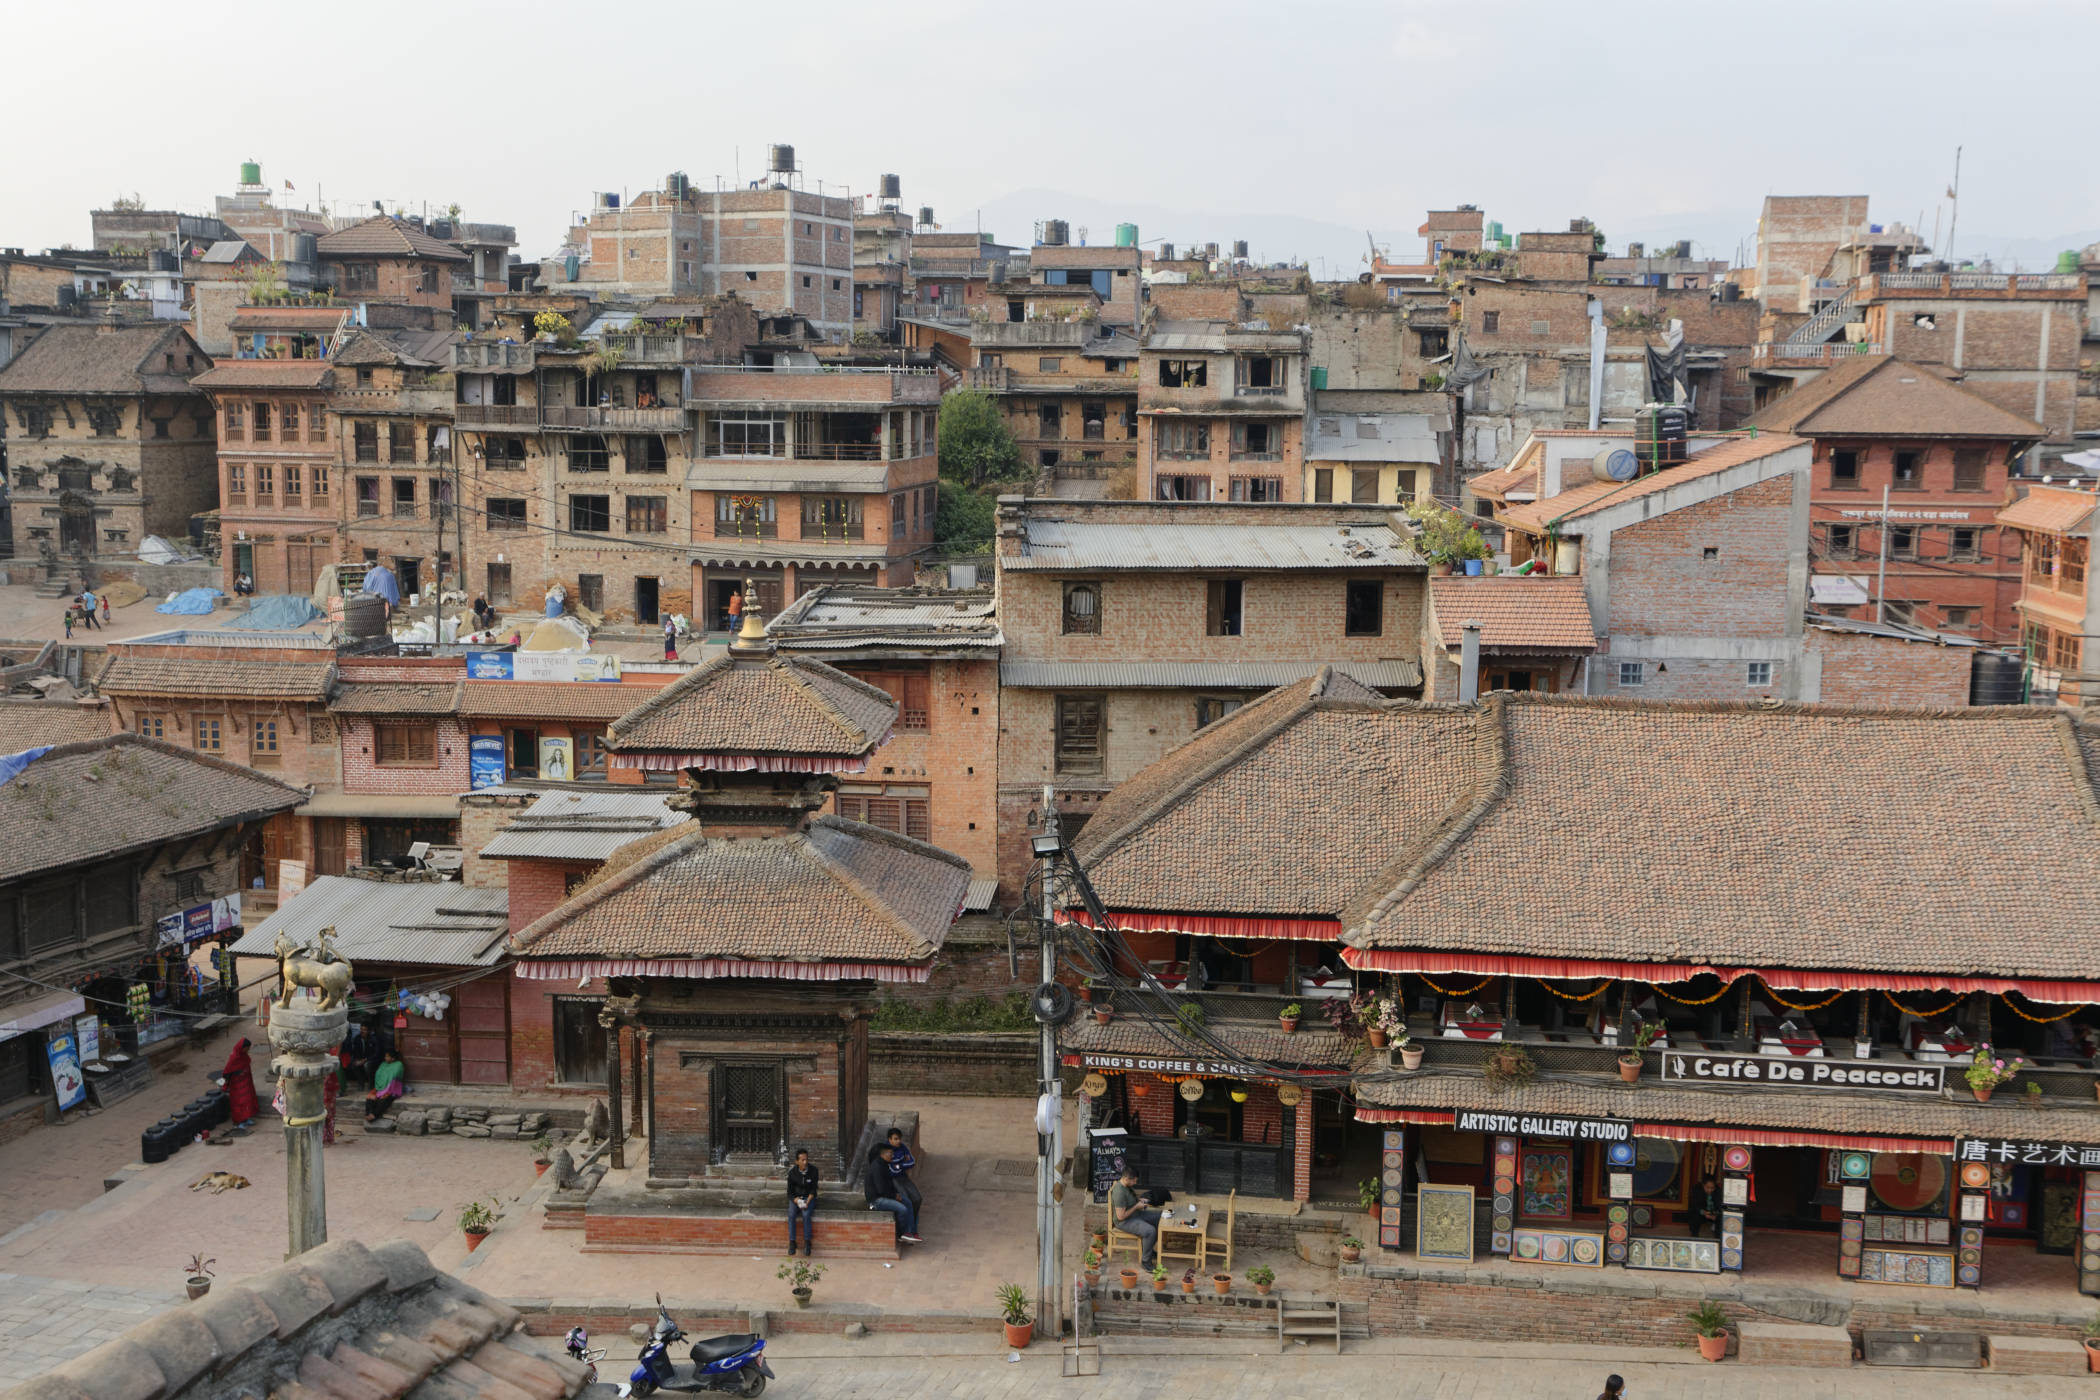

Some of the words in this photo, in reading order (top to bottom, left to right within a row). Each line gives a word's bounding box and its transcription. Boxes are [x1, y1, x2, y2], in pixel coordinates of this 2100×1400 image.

[1085, 1055, 1134, 1068] KING'S
[1138, 1059, 1191, 1072] COFFEE
[1196, 1062, 1206, 1073] &
[1768, 1062, 1805, 1081] De
[1813, 1063, 1936, 1087] Peacock
[1459, 1112, 1518, 1133] ARTISTIC
[1520, 1116, 1578, 1138] GALLERY
[1580, 1121, 1628, 1141] STUDIO
[1961, 1139, 2100, 1166] 唐卡艺术画
